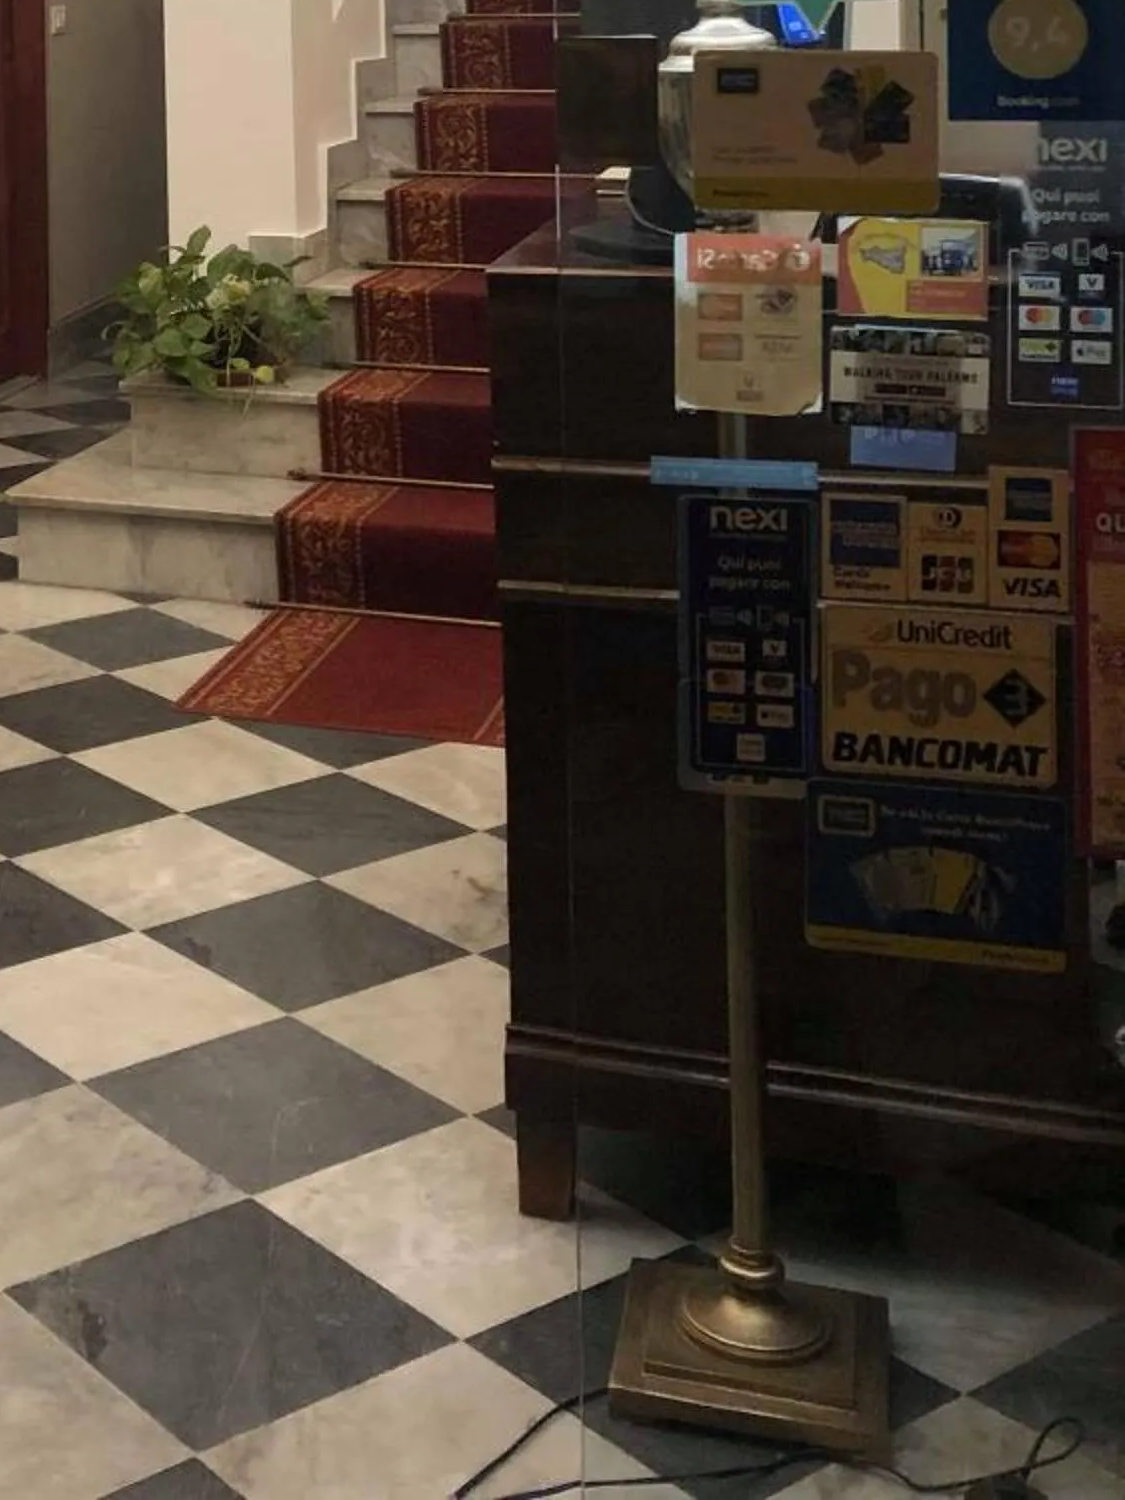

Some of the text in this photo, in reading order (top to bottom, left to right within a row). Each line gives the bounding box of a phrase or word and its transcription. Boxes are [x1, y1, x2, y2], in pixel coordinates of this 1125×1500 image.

[709, 505, 789, 532] nexi
[1003, 577, 1062, 598] VISA
[897, 620, 1013, 650] UniCredit
[832, 649, 977, 727] Pago
[833, 731, 1049, 777] BANCOMAT
